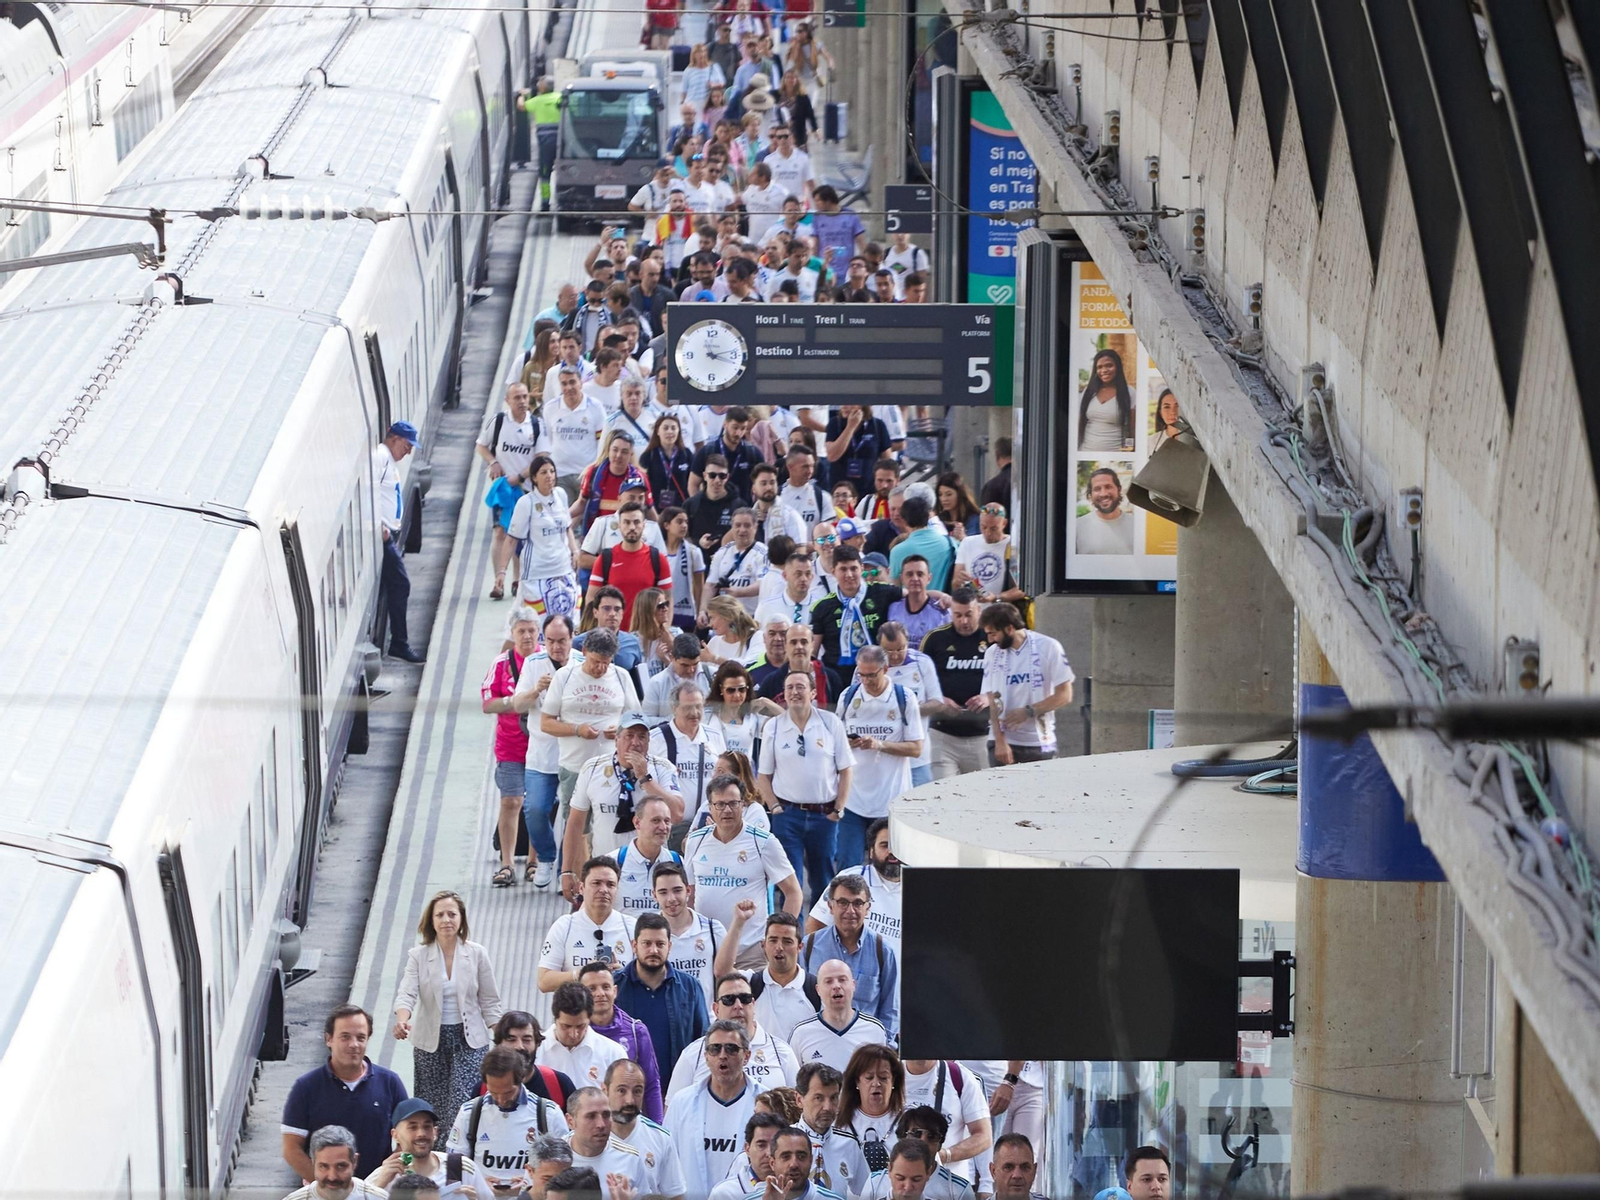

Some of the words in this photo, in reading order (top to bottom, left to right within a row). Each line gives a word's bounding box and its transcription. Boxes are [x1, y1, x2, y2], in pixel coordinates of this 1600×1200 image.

[1008, 150, 1026, 160] no
[990, 164, 1003, 176] el
[1006, 164, 1036, 180] mej
[989, 182, 1007, 193] en
[1010, 180, 1034, 194] Tra
[989, 200, 1005, 210] es
[1008, 200, 1035, 212] por
[887, 209, 901, 231] 5
[755, 315, 779, 324] Hora
[815, 315, 837, 324] Tren
[975, 315, 991, 324] Vía
[1081, 317, 1096, 327] DE
[1098, 317, 1129, 327] TODO
[707, 330, 718, 338] 12
[686, 352, 694, 360] 9
[731, 352, 738, 360] 3
[755, 346, 794, 356] Destino
[967, 357, 991, 394] 5
[502, 441, 531, 455] bwin
[728, 577, 751, 588] win
[946, 655, 986, 670] bwin
[572, 684, 587, 697] LEVI
[849, 725, 893, 737] Emirates
[714, 866, 729, 877] Fly
[697, 875, 748, 888] Emirates
[623, 896, 660, 909] Emira
[870, 911, 901, 928] mirat
